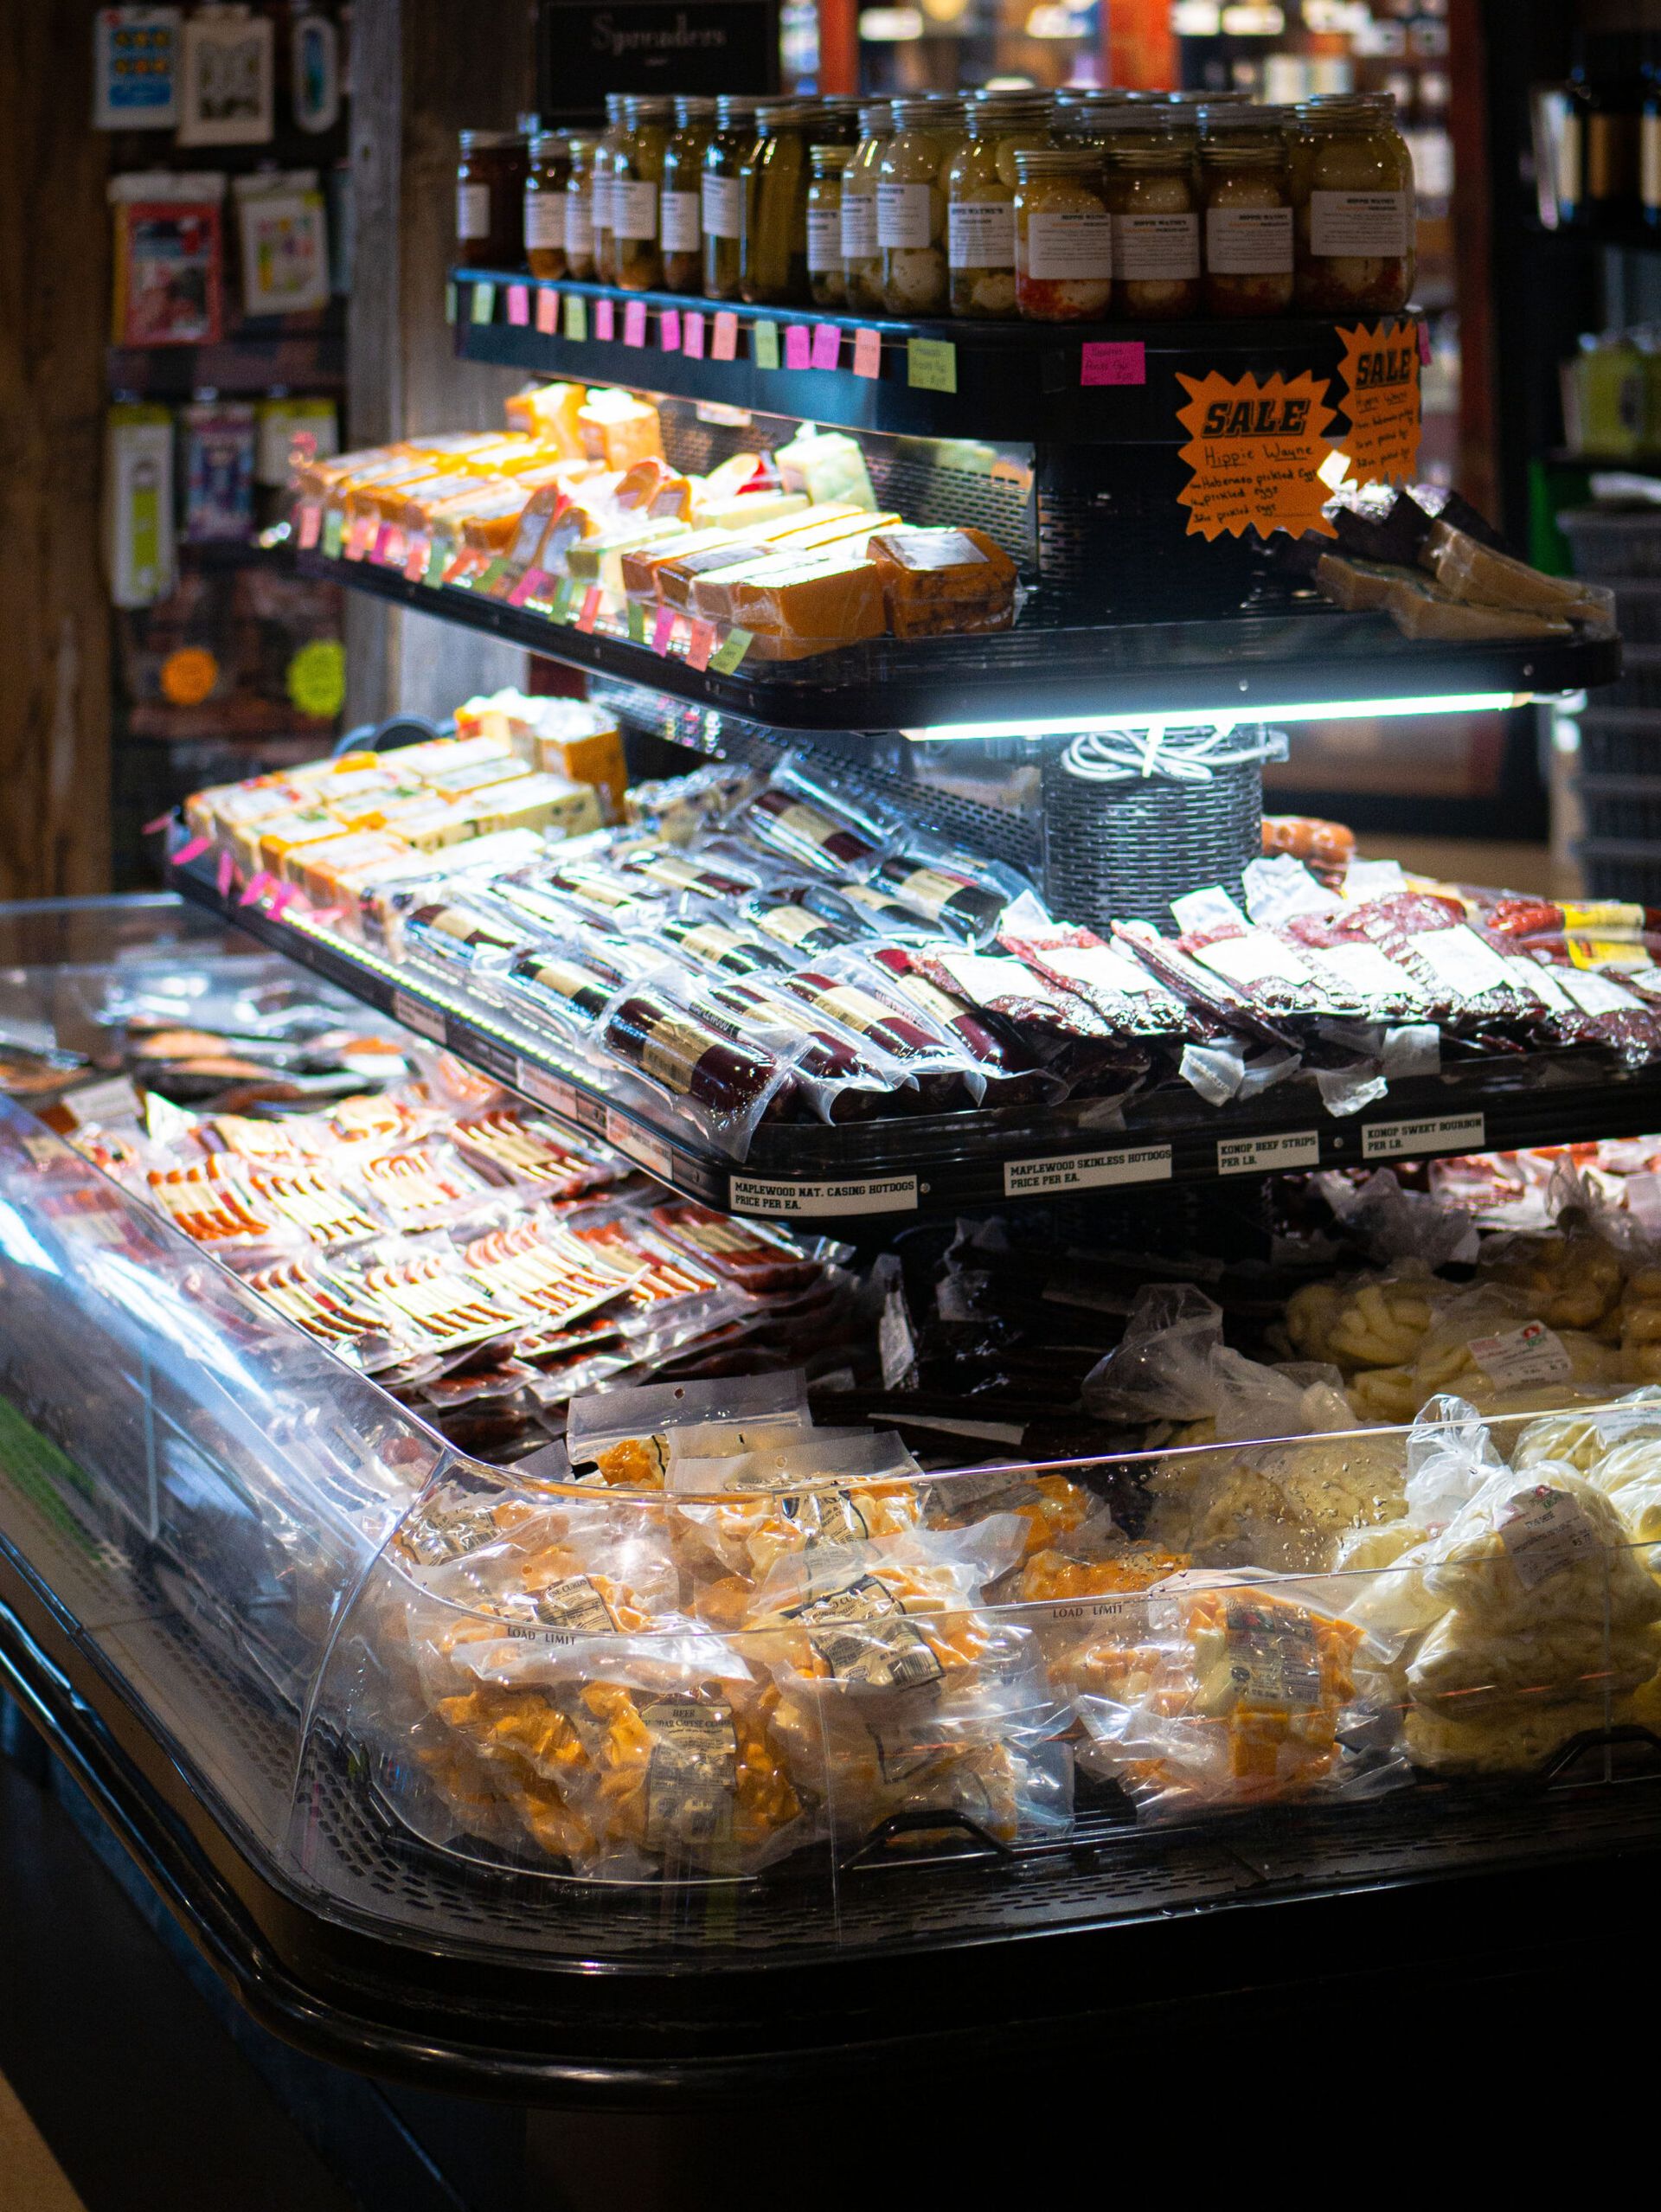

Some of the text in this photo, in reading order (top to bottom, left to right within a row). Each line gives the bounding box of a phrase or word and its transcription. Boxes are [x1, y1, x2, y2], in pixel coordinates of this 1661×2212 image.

[1355, 348, 1412, 390] SALE
[1201, 398, 1311, 439] SALE
[1204, 443, 1313, 469] Hippie Wayne
[1367, 1118, 1483, 1139] KONOP SWEET BOURBON
[1221, 1136, 1317, 1156] KONOP BEEF STRIPS
[1368, 1138, 1403, 1151] PER LB.
[1010, 1149, 1172, 1177] MAPLEWOOD SKINLESS HOTDOGS
[1222, 1156, 1258, 1168] PER LB.
[734, 1181, 914, 1197] MAPLEWOOD NAT. CASING HOTDOGS
[1010, 1172, 1081, 1189] PRICE PER EA.
[735, 1195, 802, 1210] PRICE PER EA.
[1052, 1604, 1123, 1619] LOAD LIMIT
[507, 1626, 577, 1645] LOAD LIMIT
[672, 1709, 696, 1718] BEER
